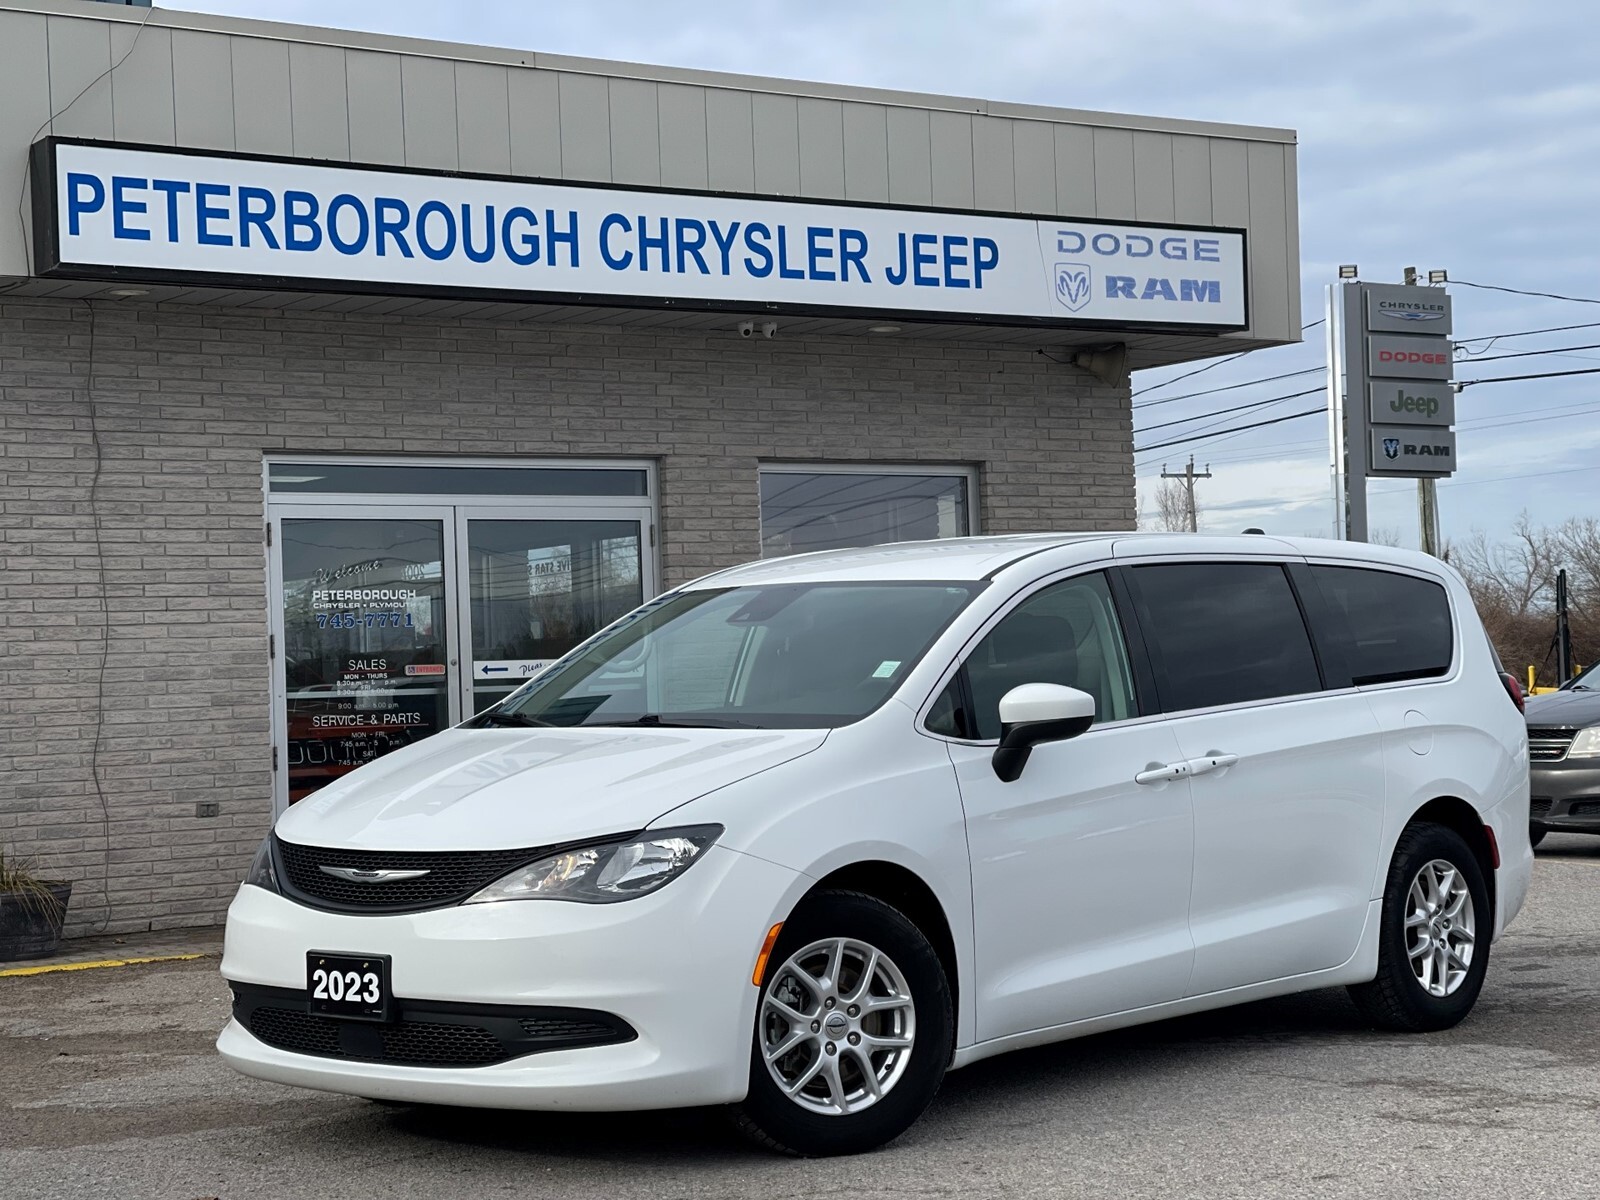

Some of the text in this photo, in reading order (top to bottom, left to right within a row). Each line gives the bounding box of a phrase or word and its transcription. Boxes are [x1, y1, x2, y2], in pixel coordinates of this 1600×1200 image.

[66, 172, 999, 289] PETERBOROUGH CHRYSLER JEEP
[1057, 230, 1220, 262] DODGE
[1105, 275, 1221, 303] RAM
[1379, 301, 1445, 312] CHRYSLER
[1379, 351, 1447, 365] DODGE
[1390, 389, 1439, 418] Jeep
[1403, 444, 1450, 456] RAM
[315, 560, 382, 583] Welcome
[312, 589, 417, 601] PETERBOROUGH
[316, 612, 414, 629] 745-7771
[348, 659, 387, 670] SALES
[519, 662, 547, 676] Pleas
[312, 712, 421, 727] SERVICE & PARTS
[313, 969, 380, 1003] 2023
